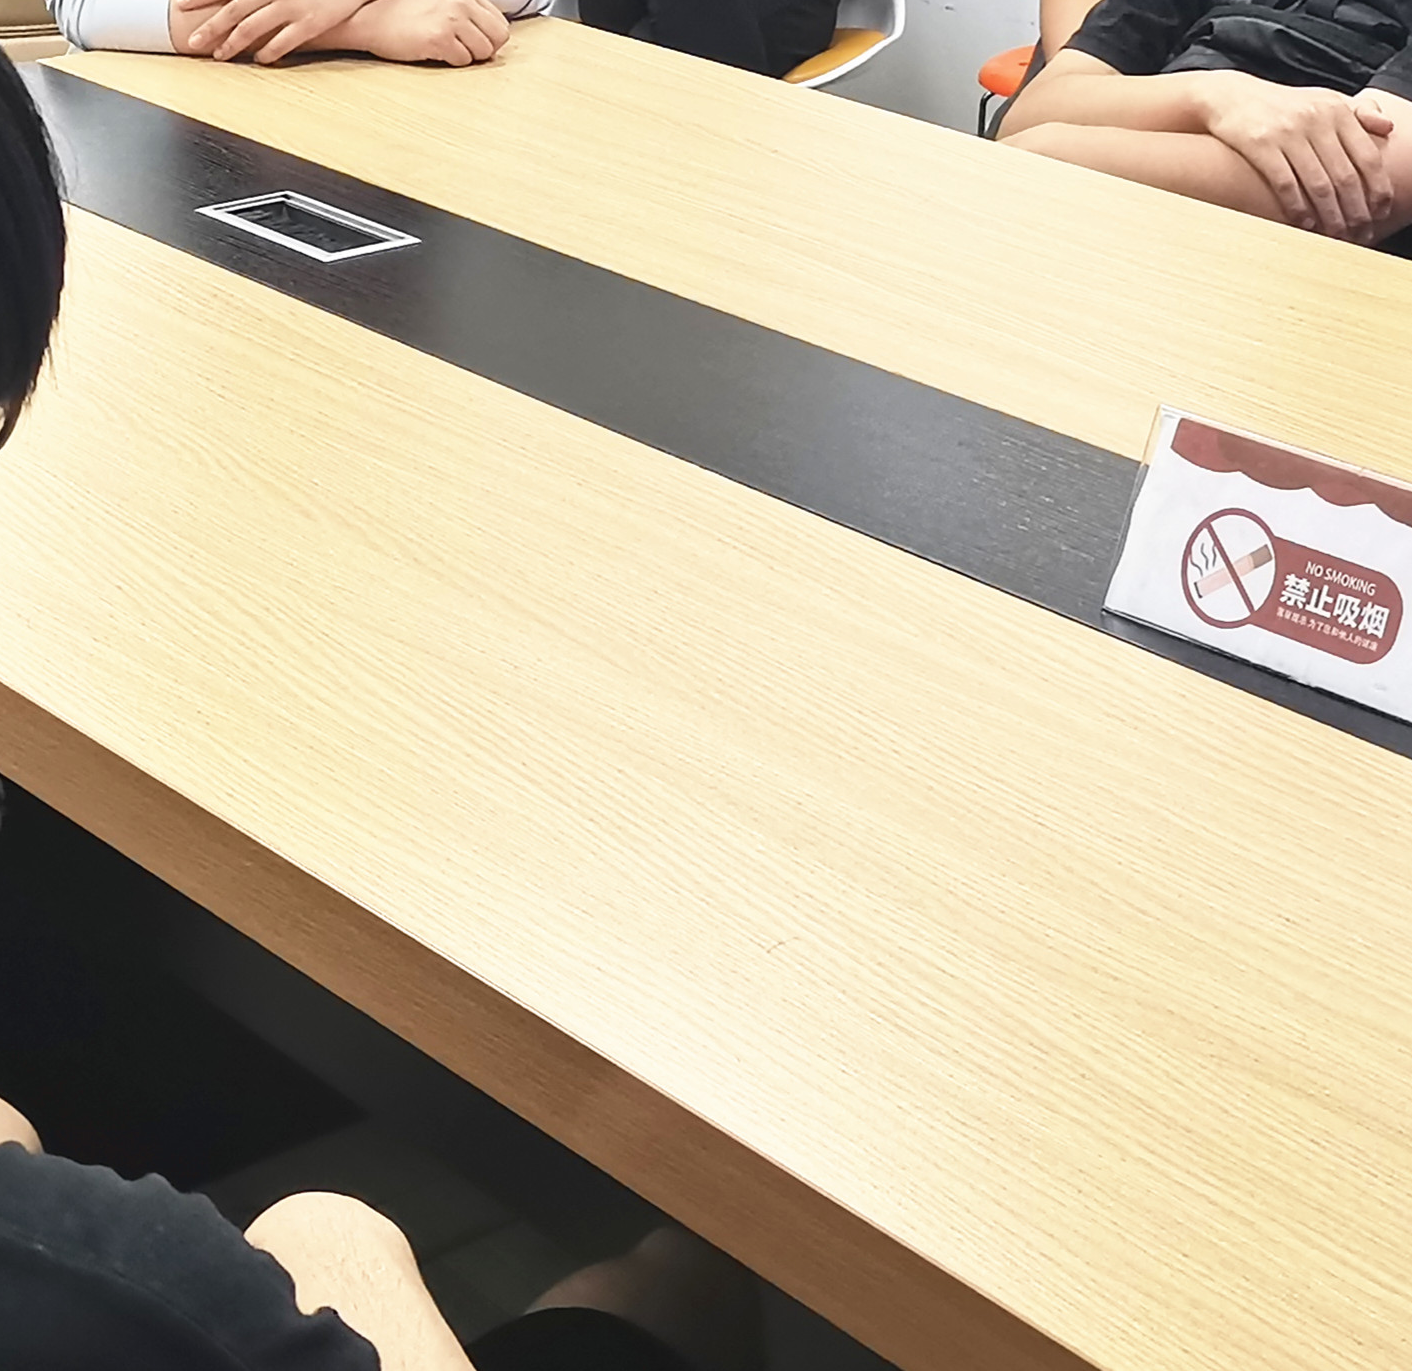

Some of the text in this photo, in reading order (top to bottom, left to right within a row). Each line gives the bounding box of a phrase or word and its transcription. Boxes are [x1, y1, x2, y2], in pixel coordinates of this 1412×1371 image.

[1305, 561, 1377, 596] NO SMOKING
[1279, 573, 1390, 639] 禁止吸烟
